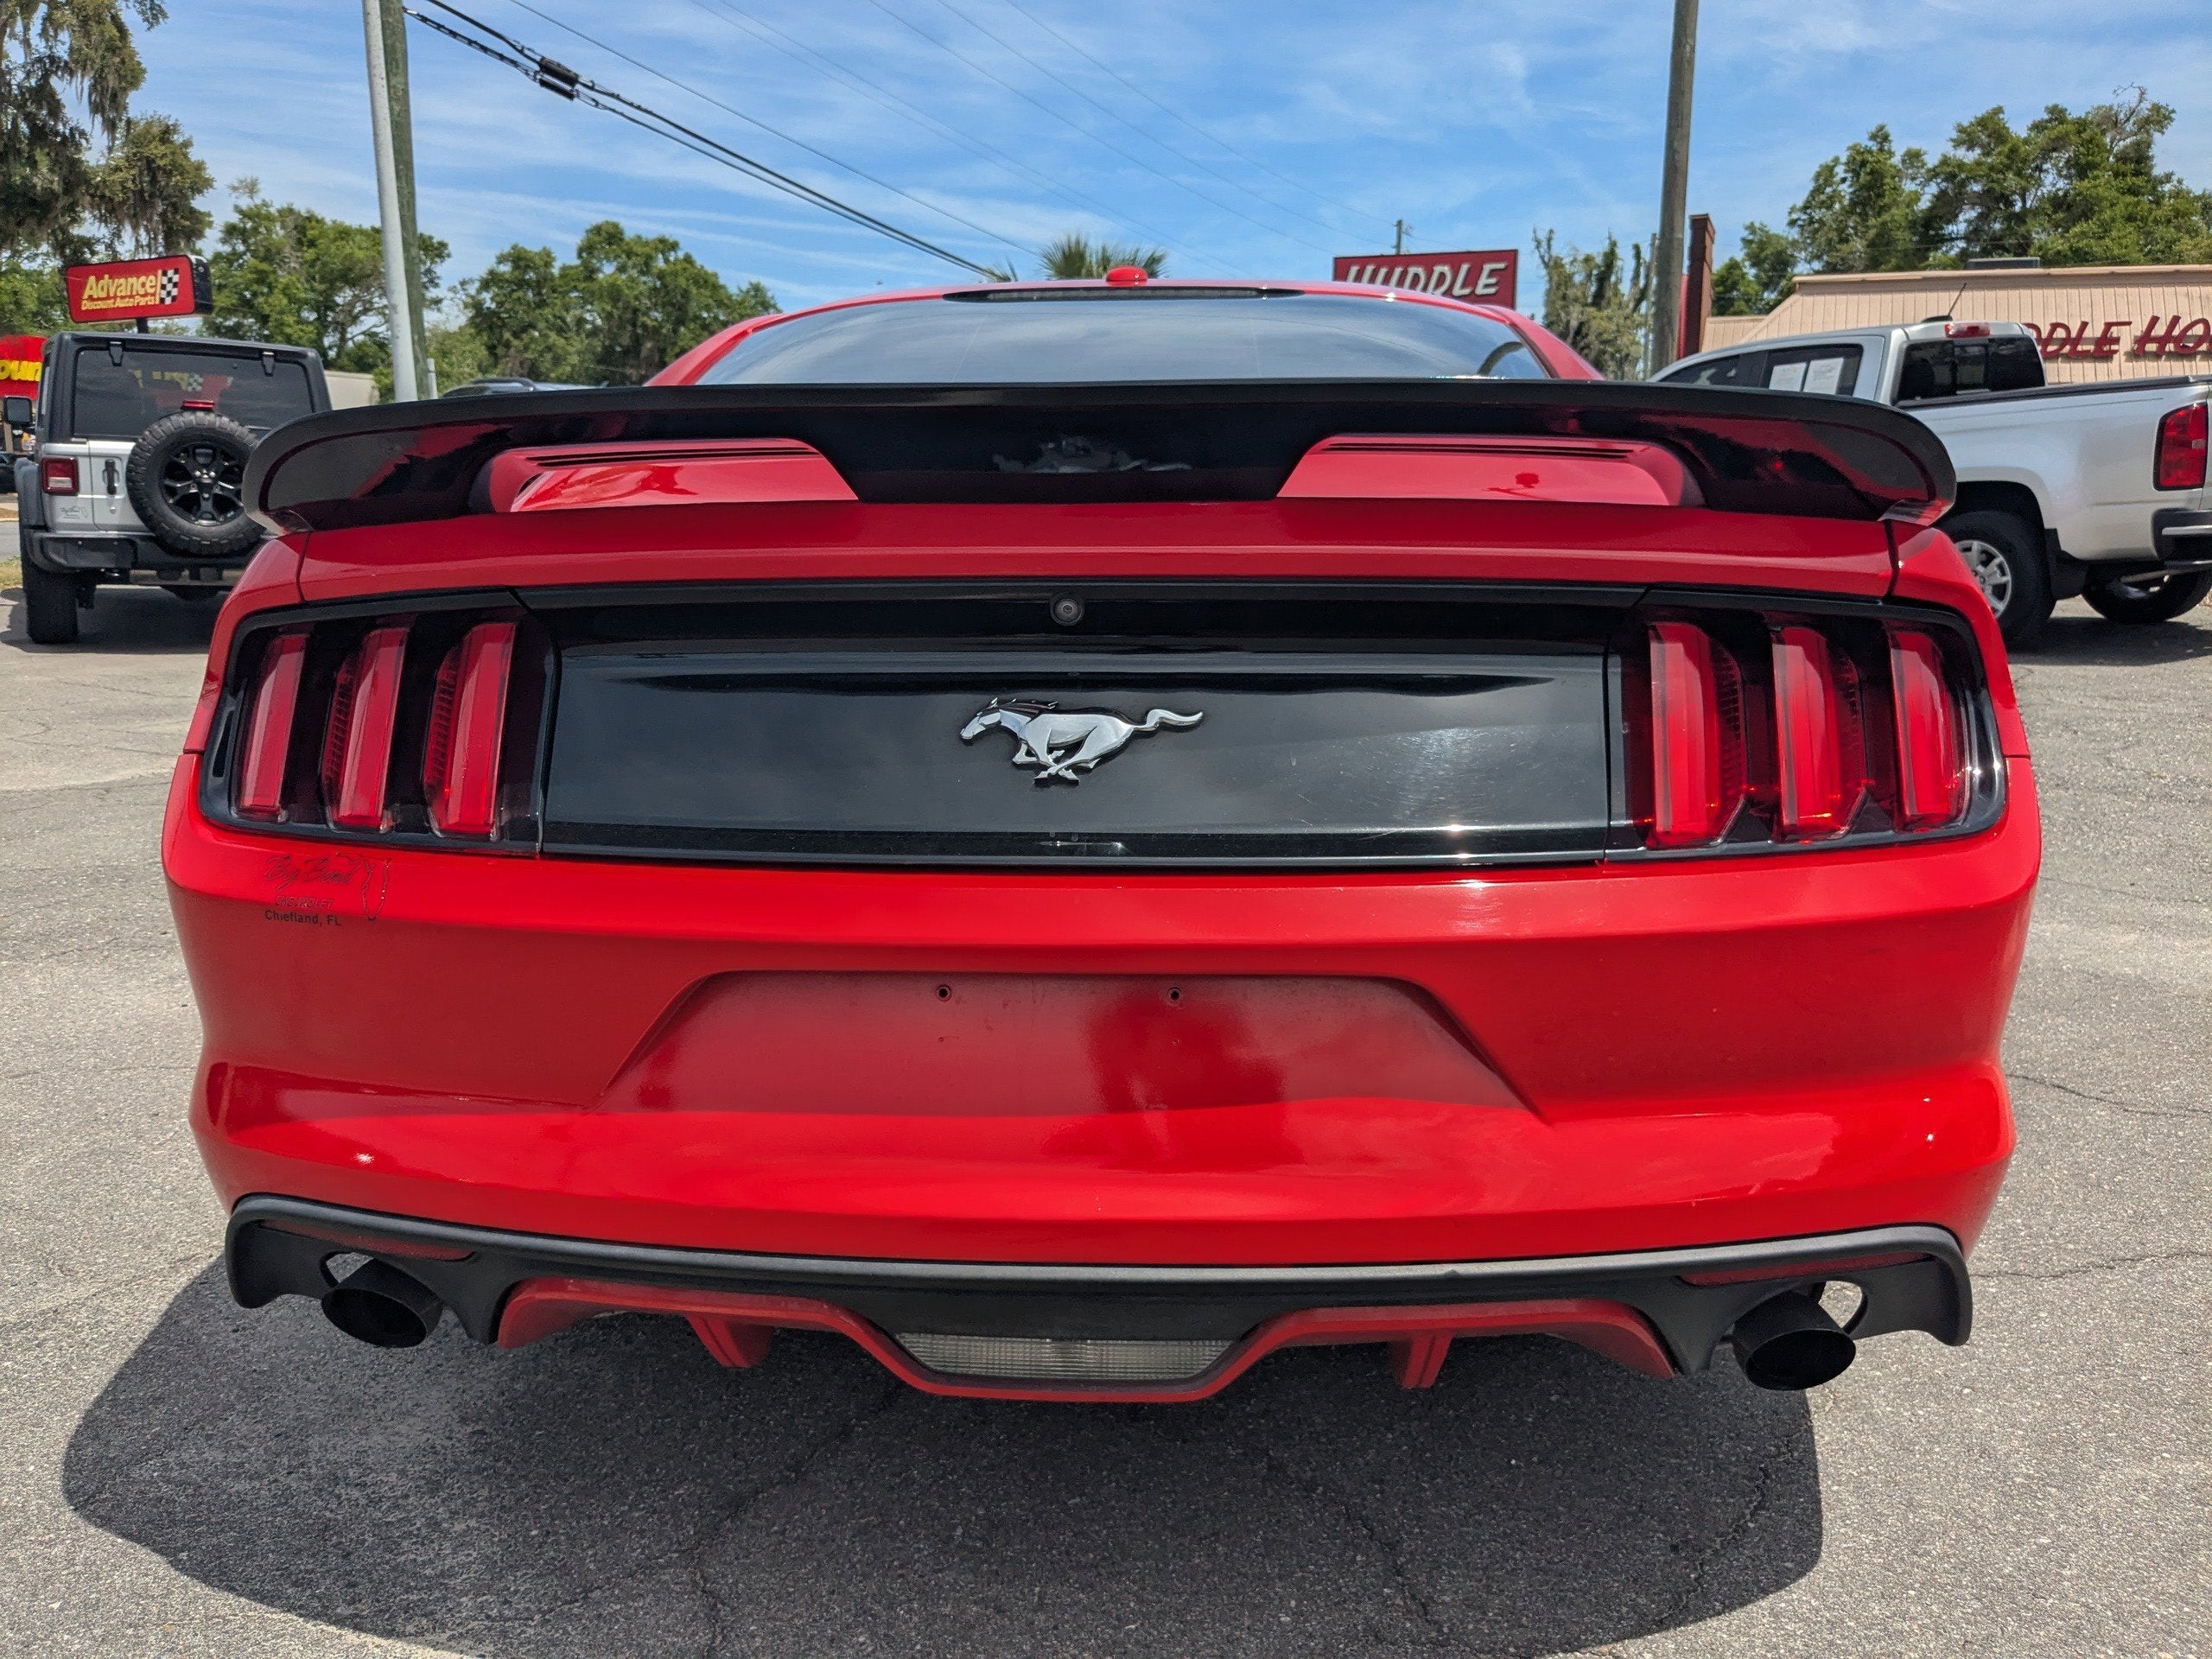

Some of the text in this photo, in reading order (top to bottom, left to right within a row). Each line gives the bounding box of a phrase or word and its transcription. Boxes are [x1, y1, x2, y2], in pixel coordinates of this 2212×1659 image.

[82, 274, 156, 300] Advance
[115, 297, 135, 308] Auto
[135, 296, 156, 306] Parts
[2133, 315, 2212, 356] HO
[264, 909, 341, 927] Chiefland, FL
